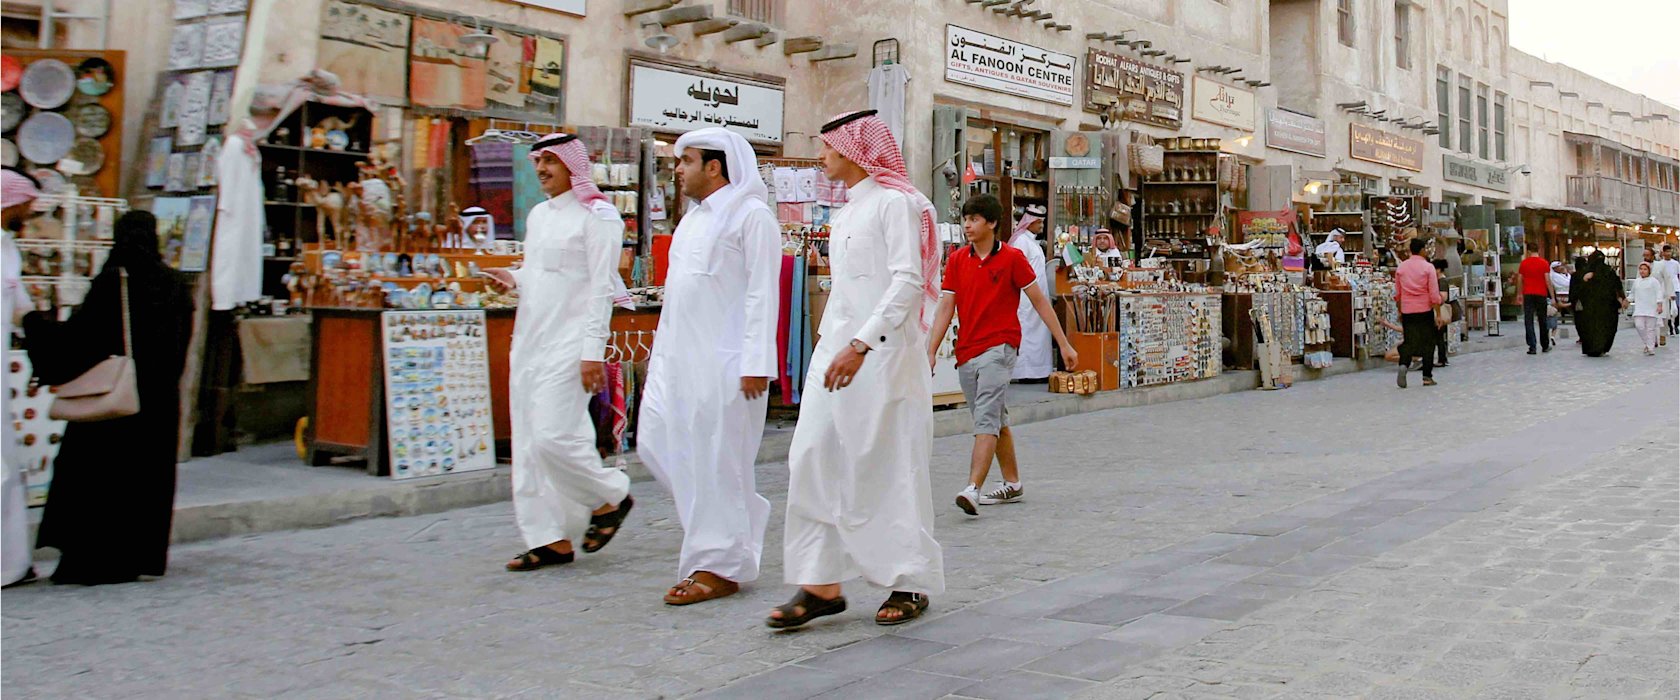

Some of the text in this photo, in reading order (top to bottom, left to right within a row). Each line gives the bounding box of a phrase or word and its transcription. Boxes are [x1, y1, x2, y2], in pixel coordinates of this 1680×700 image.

[951, 34, 1071, 71] مركز الفنون
[951, 49, 1072, 86] AL FANOON CENTRE
[951, 61, 973, 72] GIFTS,
[975, 67, 1009, 80] ANTIQUES
[1016, 76, 1037, 85] QATAR
[1038, 81, 1072, 93] SOUVENIRS
[1140, 66, 1162, 80] ANTIQUES
[1167, 73, 1180, 84] GIFTS
[687, 79, 739, 108] لحويله
[662, 108, 702, 123] الرجاليه
[704, 113, 759, 129] للمستلزمات
